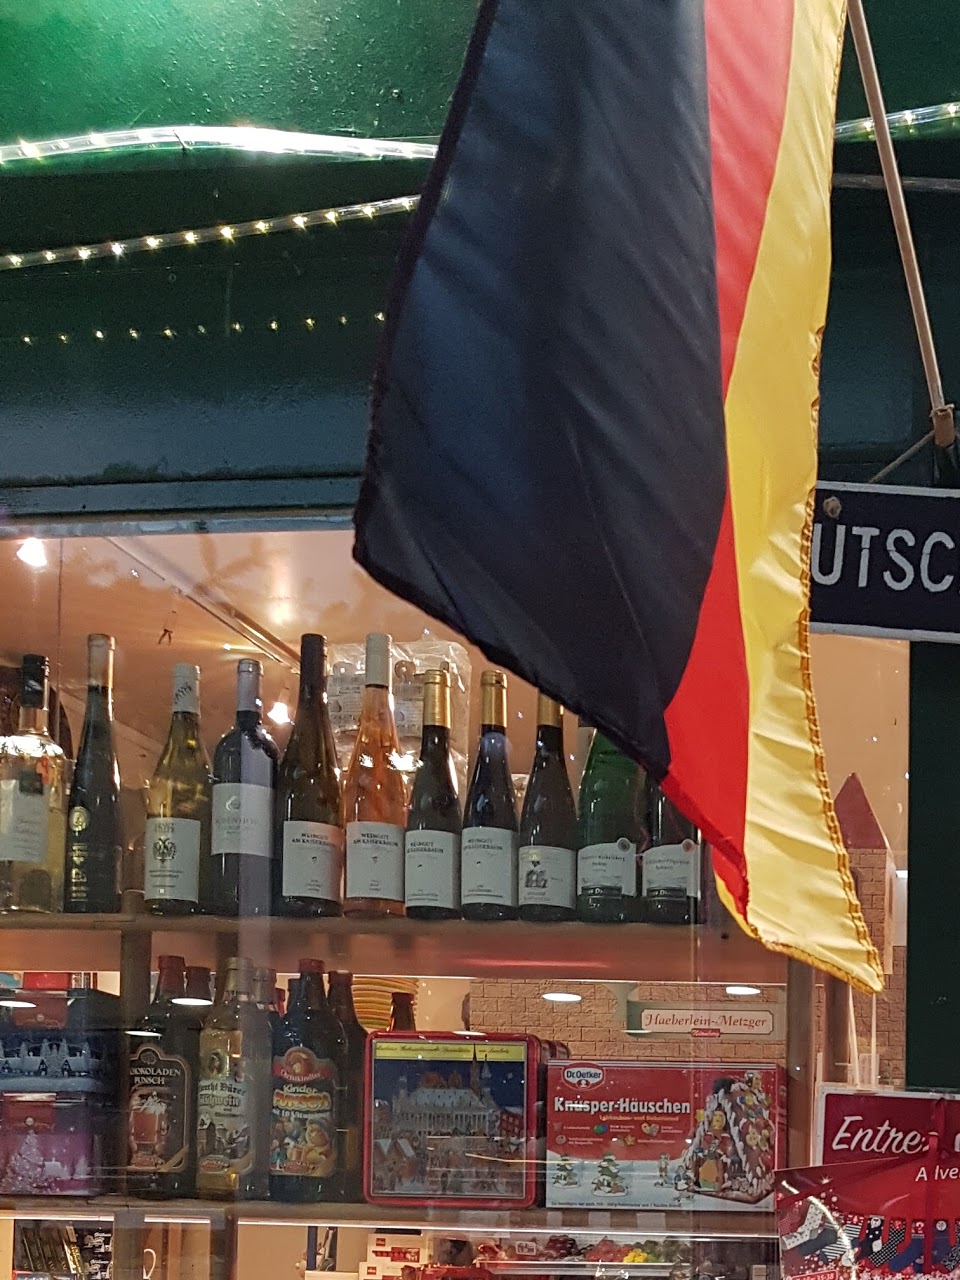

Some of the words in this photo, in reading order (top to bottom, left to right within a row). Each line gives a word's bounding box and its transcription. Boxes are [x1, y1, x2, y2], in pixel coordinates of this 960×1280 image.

[645, 1011, 767, 1029] Haeberlein-Metzger
[283, 1084, 318, 1094] Kinder
[554, 1096, 691, 1114] Knusper-Häuschen
